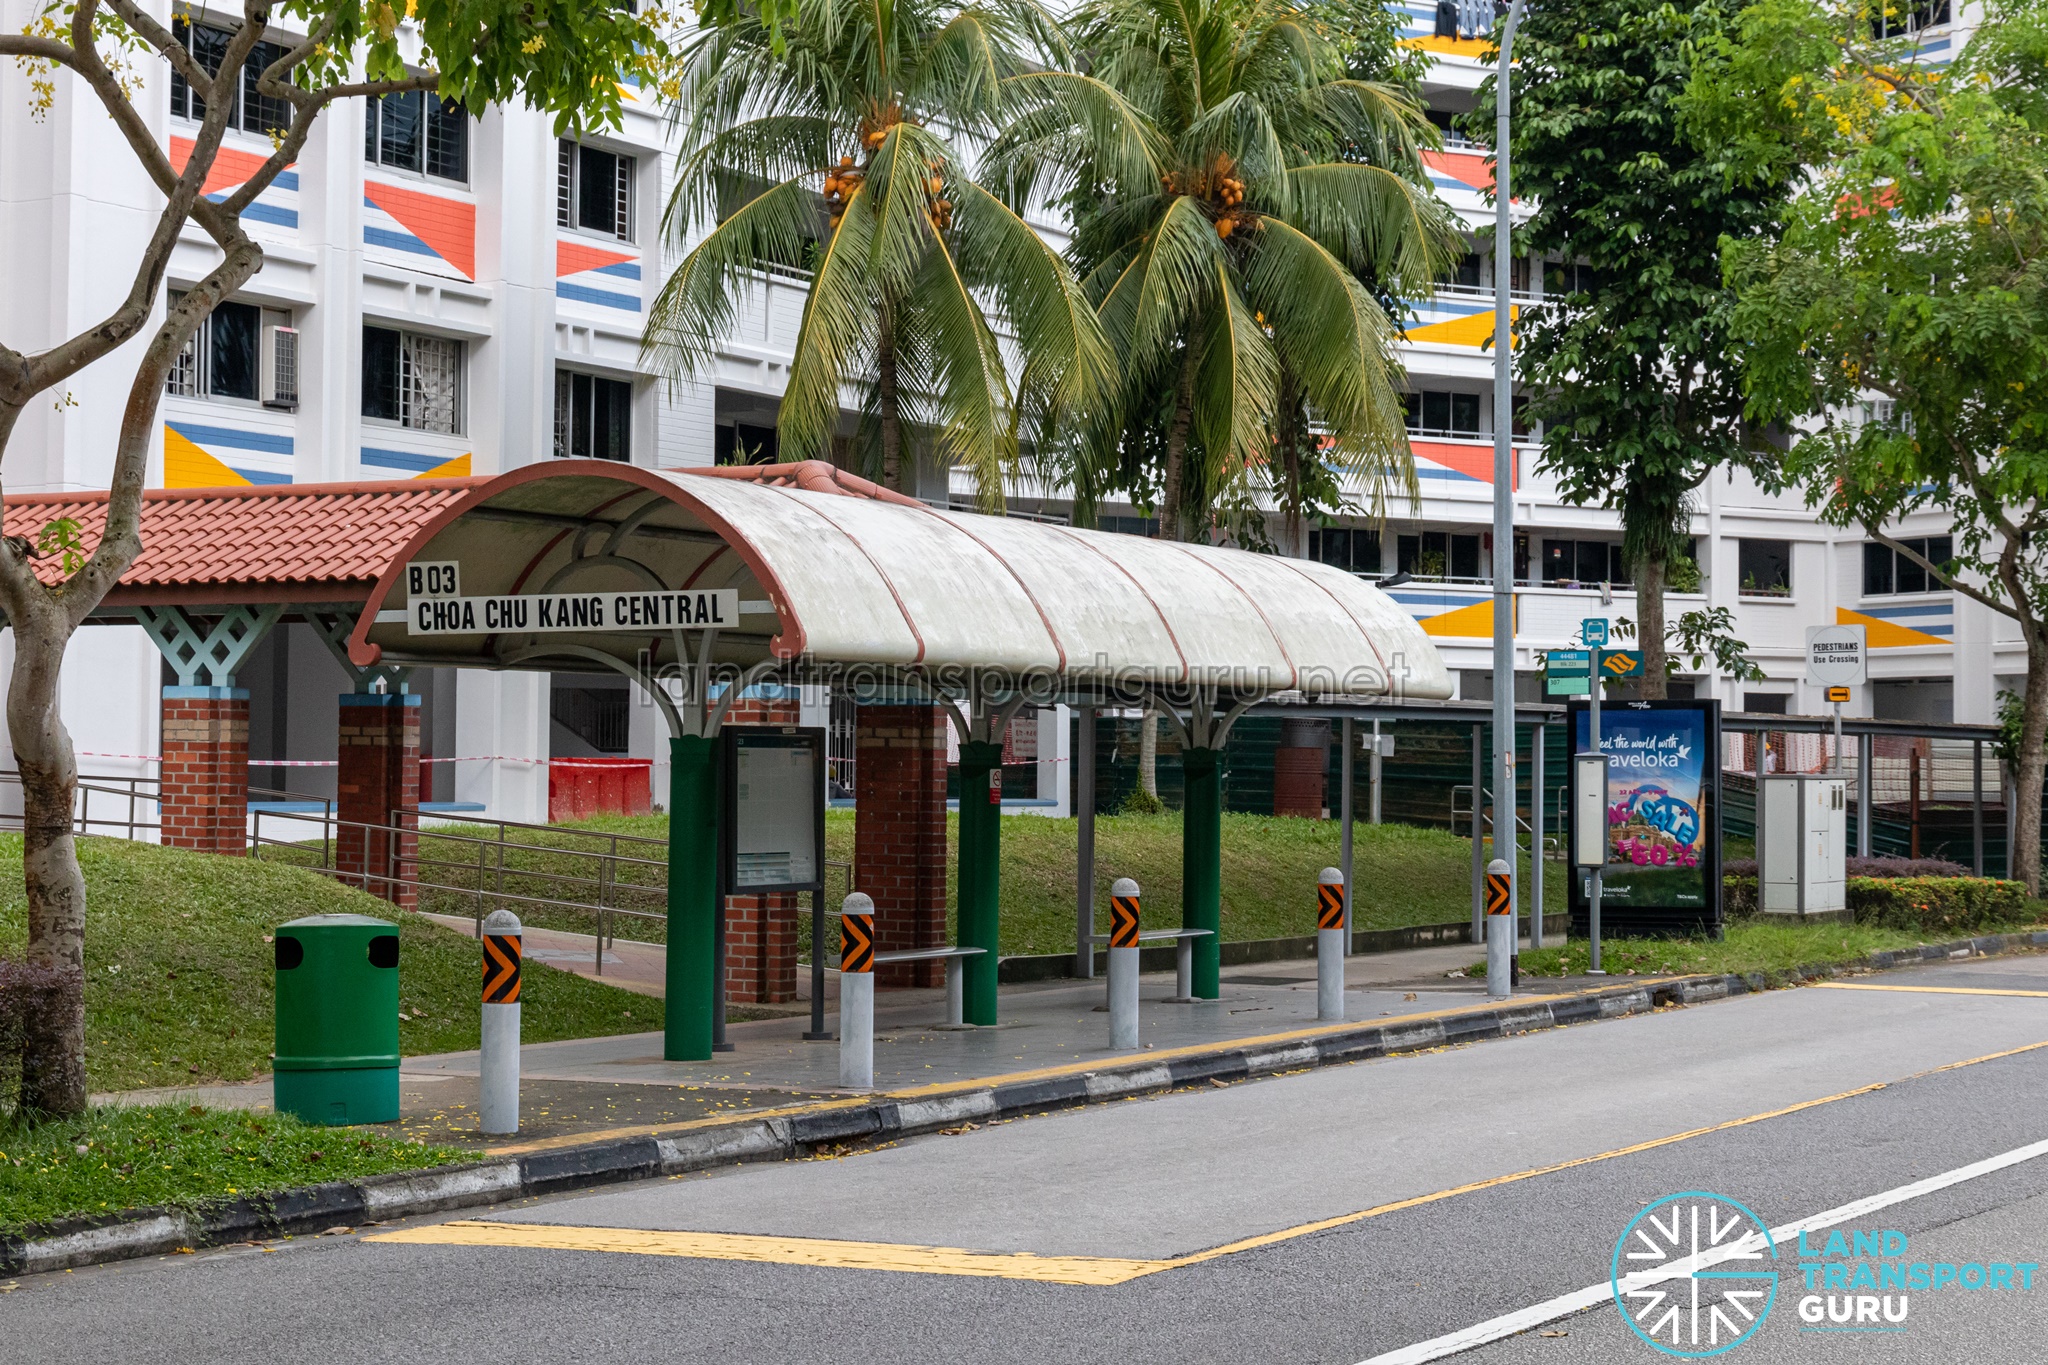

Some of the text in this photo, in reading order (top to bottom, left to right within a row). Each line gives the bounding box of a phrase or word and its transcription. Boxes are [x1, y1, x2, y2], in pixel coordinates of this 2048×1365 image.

[409, 565, 456, 595] B03
[418, 593, 724, 631] CHOA CHU KANG CENTRAL
[1814, 642, 1858, 651] PEDESTRIANS
[1829, 655, 1858, 663] Crossing
[1599, 733, 1679, 752] eel the world with
[1608, 751, 1679, 768] aveloka
[1639, 800, 1695, 845] SALE
